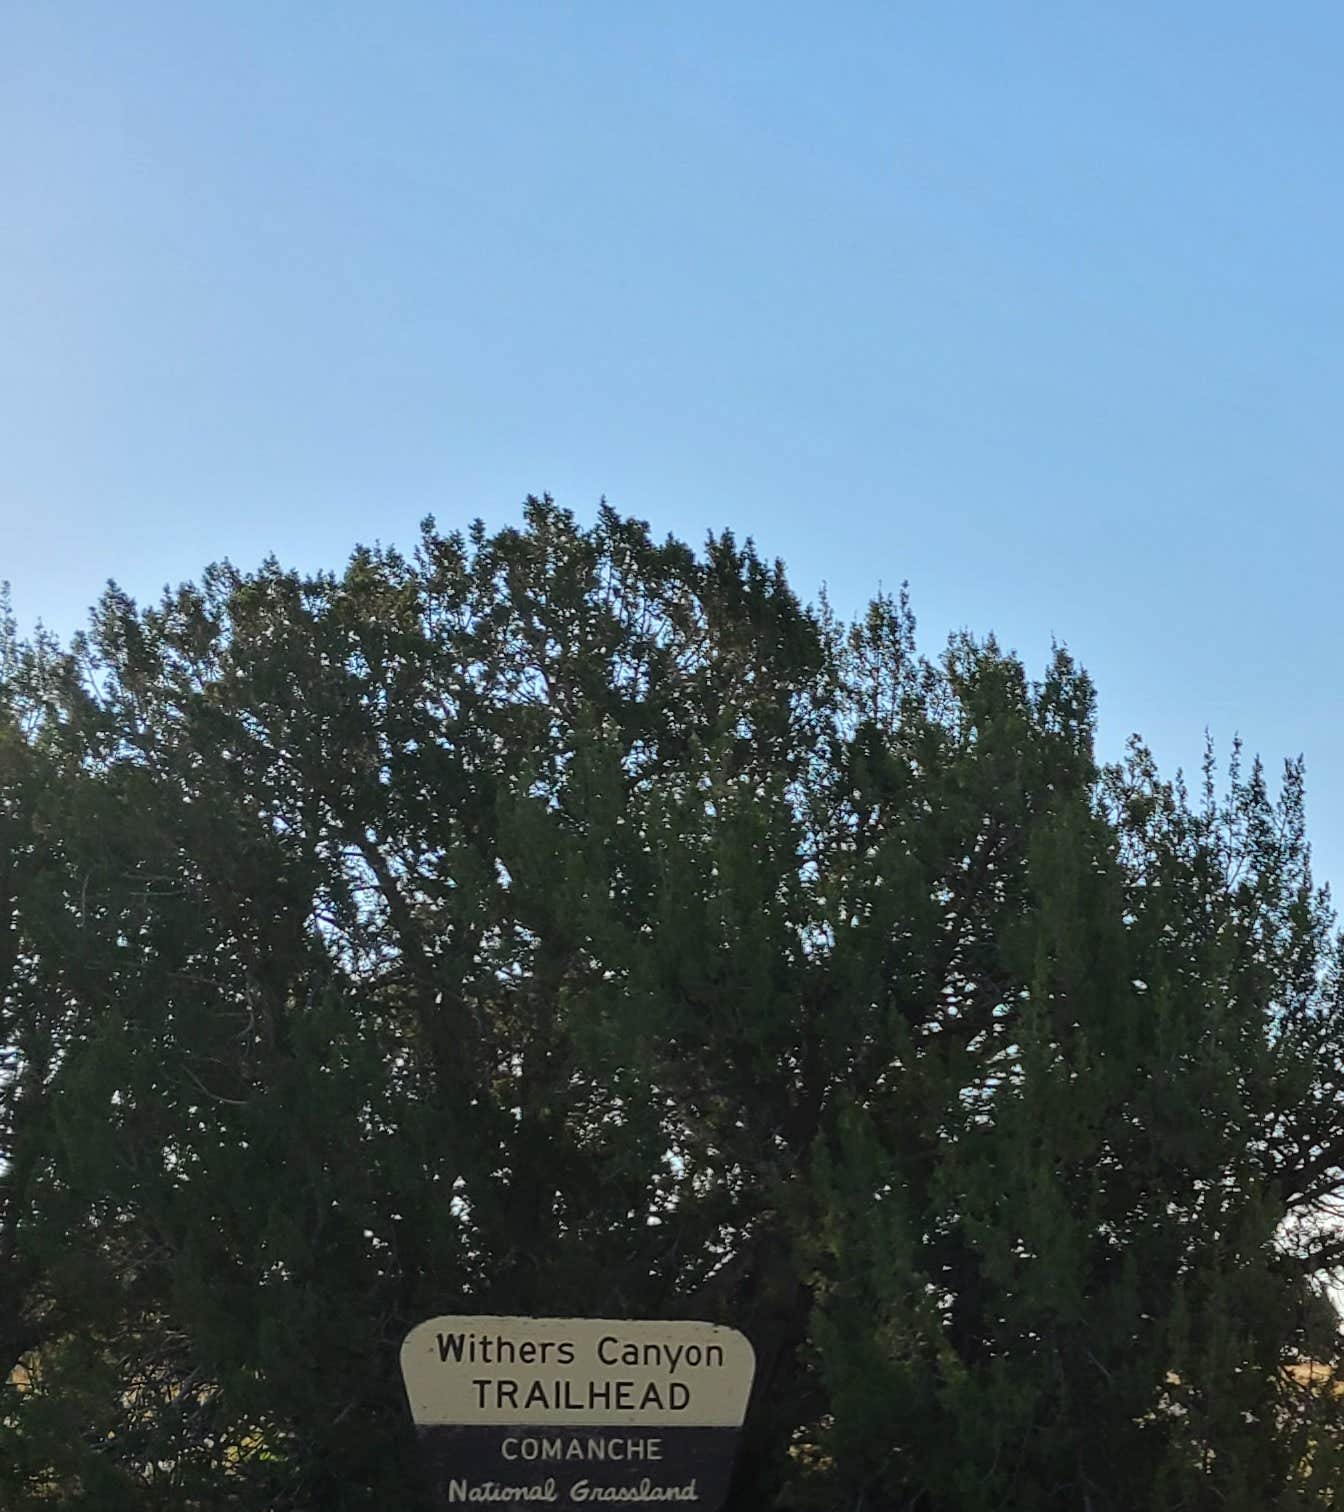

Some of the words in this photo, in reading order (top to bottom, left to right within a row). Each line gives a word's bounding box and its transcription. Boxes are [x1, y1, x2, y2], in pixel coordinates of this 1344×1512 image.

[436, 1333, 575, 1364] Withers
[597, 1337, 724, 1373] Canyon
[472, 1380, 690, 1410] TRAILHEAD
[501, 1438, 663, 1461] COMANCHE
[449, 1479, 557, 1502] National
[570, 1479, 698, 1502] Grassland
